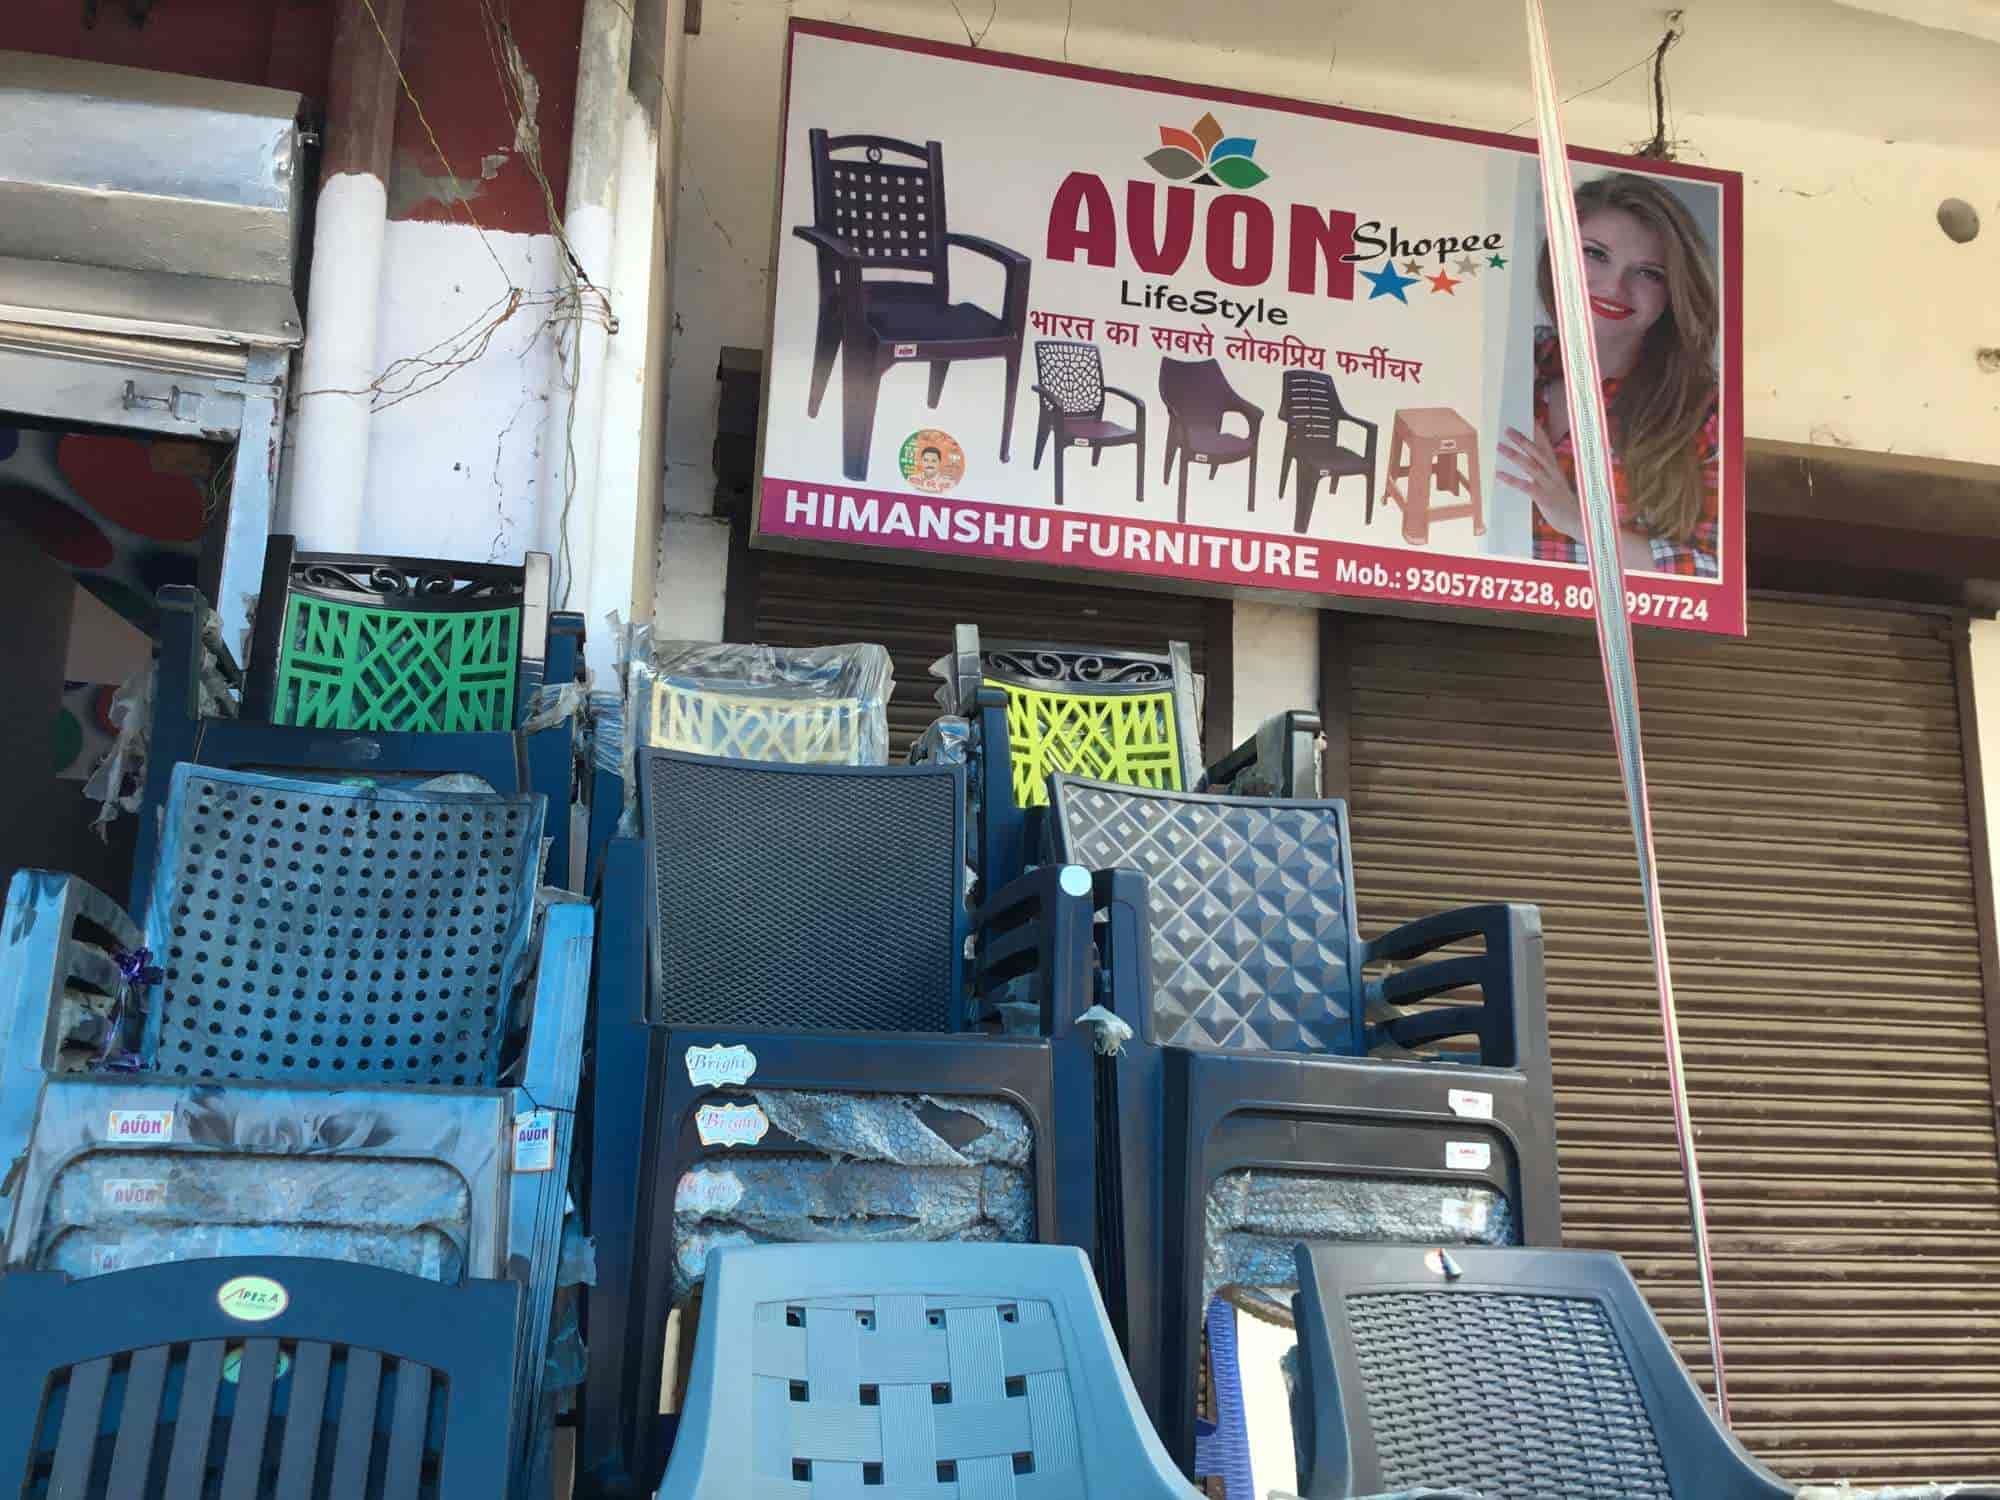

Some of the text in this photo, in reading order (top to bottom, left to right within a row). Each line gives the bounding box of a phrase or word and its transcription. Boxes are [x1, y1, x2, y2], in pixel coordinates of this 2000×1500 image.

[1046, 171, 1505, 300] AVON Shopee
[1120, 279, 1289, 328] LifeStyle
[1030, 310, 1423, 384] भारत का सबसे लोकप्रिय फर्नीचर
[784, 489, 1050, 551] HIMANSHU
[1061, 519, 1320, 579] FURNITURE
[1565, 584, 1709, 622] 80997724
[120, 1119, 162, 1134] AVON
[519, 1128, 549, 1142] AVON
